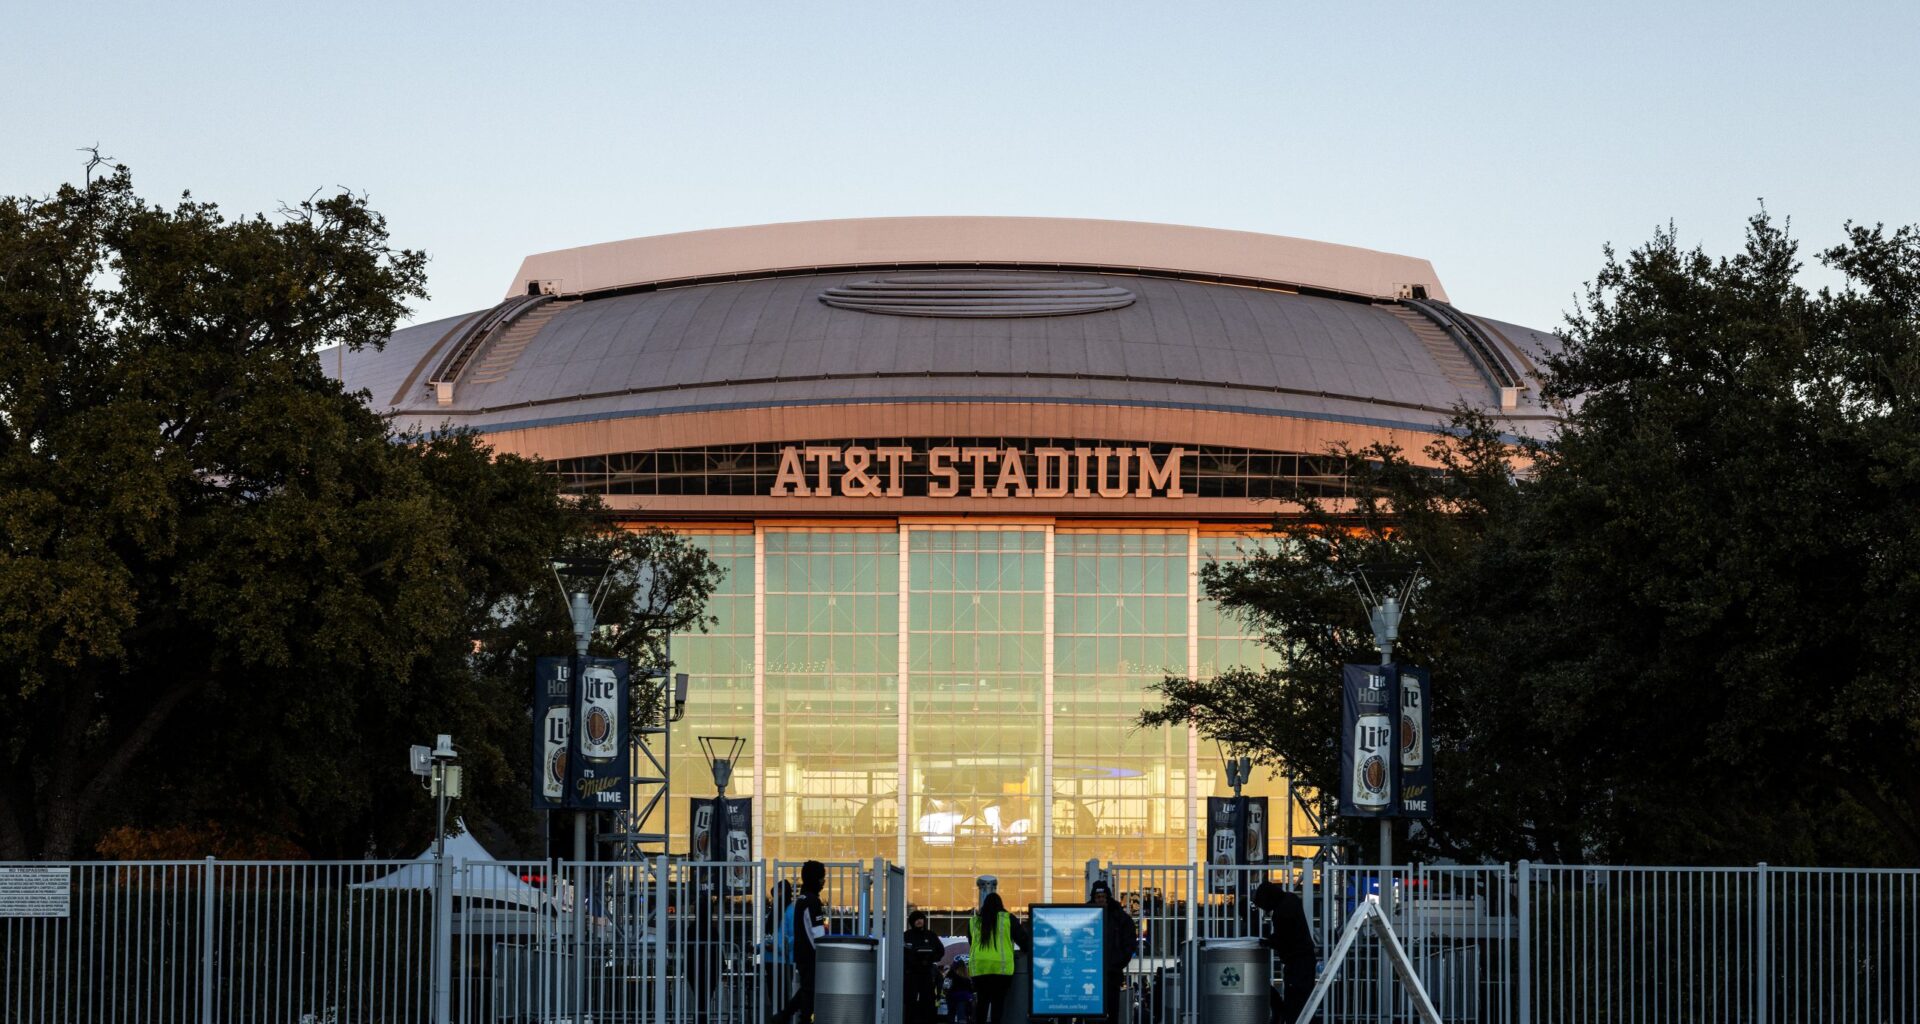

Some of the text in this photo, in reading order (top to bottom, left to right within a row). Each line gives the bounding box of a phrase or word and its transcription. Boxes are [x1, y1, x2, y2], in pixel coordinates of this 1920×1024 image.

[770, 446, 1184, 498] AT&T STADIUM
[557, 665, 571, 682] Li
[583, 675, 615, 704] Lite
[548, 717, 570, 745] Li
[1359, 725, 1390, 754] Lite
[583, 769, 595, 778] IT'S
[576, 776, 622, 799] Miller
[1401, 785, 1427, 800] iller
[597, 791, 622, 803] TIME
[1404, 799, 1427, 812] TIME
[697, 811, 711, 829] Li
[1216, 835, 1234, 853] Lite
